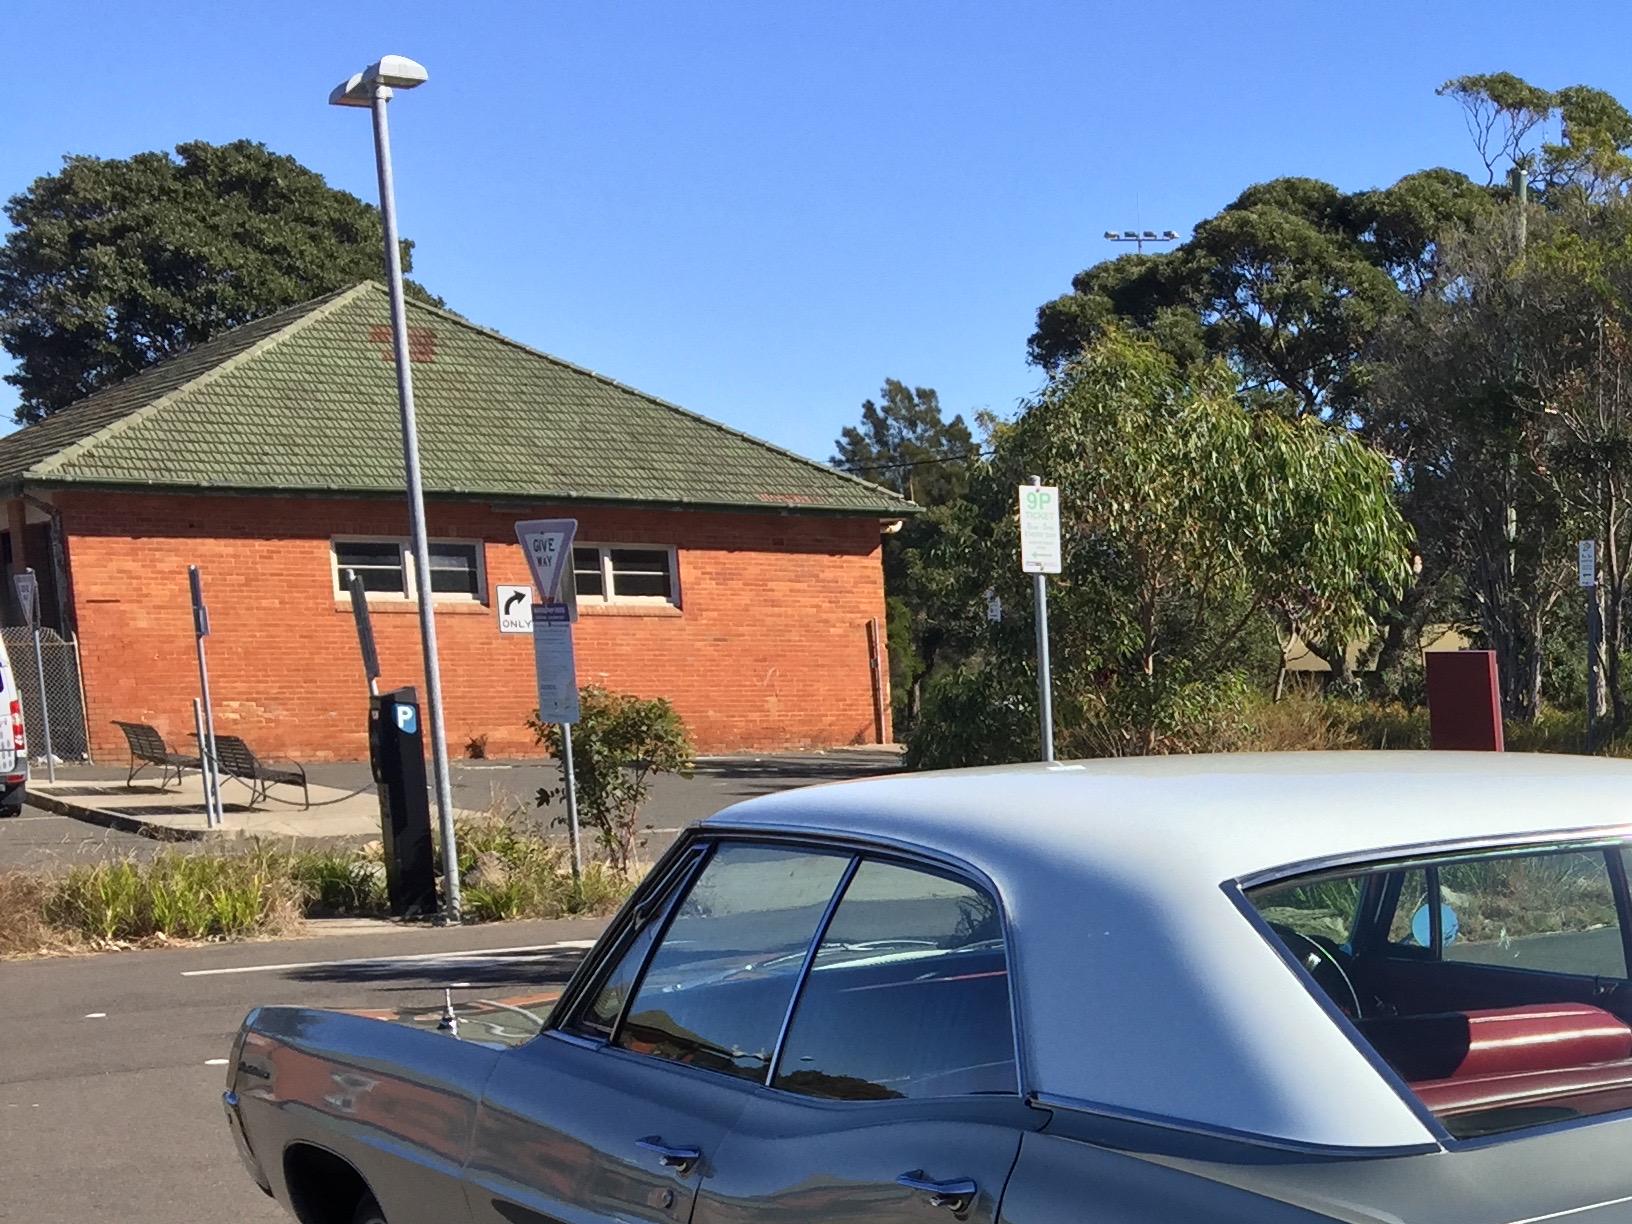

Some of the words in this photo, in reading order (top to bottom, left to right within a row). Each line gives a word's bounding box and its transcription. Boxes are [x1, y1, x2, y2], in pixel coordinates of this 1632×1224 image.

[1027, 492, 1051, 510] 9P
[533, 538, 555, 552] GIVE
[536, 555, 552, 567] WAY
[502, 619, 531, 629] ONLY
[397, 706, 413, 728] P
